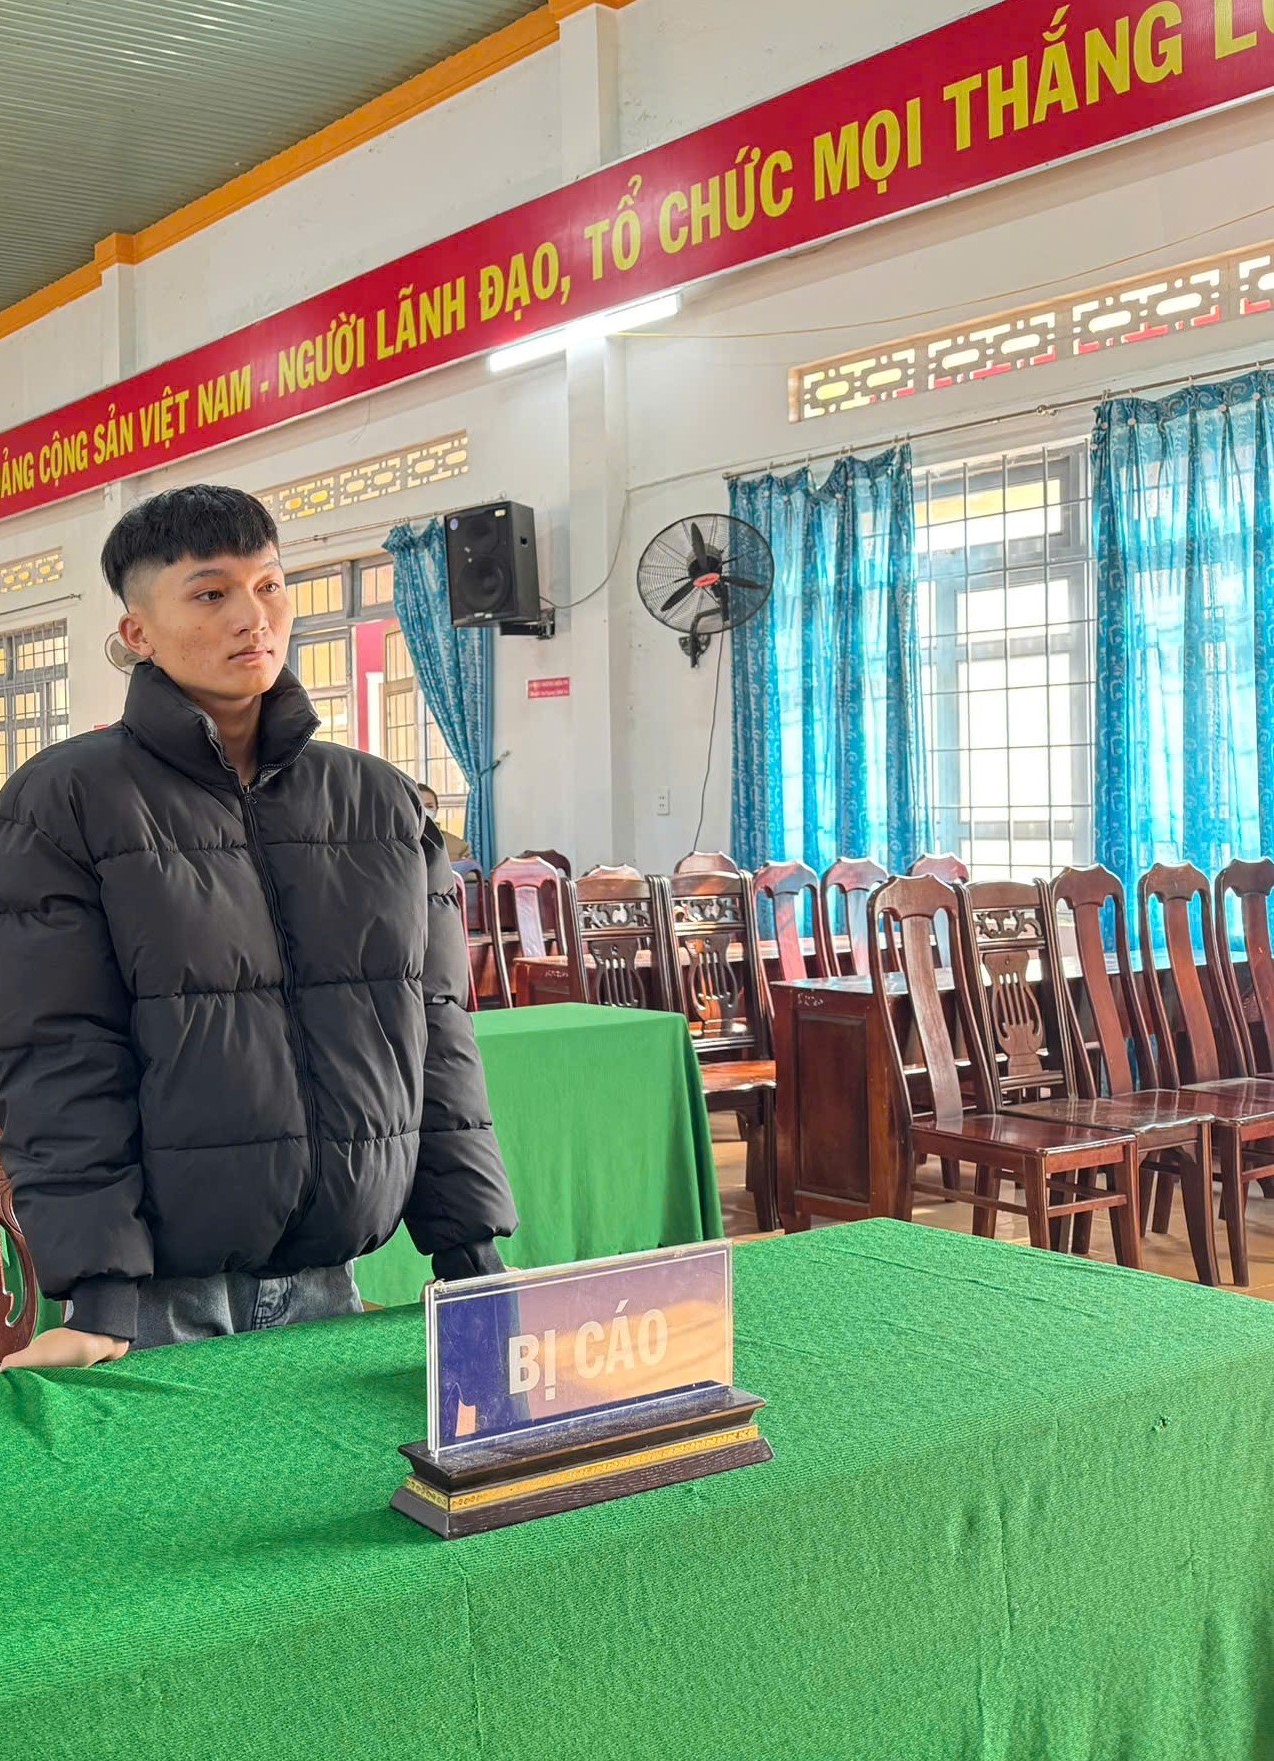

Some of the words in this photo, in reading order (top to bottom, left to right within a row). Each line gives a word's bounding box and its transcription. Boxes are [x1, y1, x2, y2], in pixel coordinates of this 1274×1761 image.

[39, 431, 88, 484] CỘNG
[94, 403, 133, 465] SẢN
[140, 385, 190, 450] VIỆT
[198, 364, 252, 428] NAM
[278, 312, 365, 395] NGƯỜI
[377, 284, 466, 361] LÃNH
[478, 241, 572, 322] ĐẠO,
[584, 174, 643, 281] TỔ
[659, 145, 794, 254] CHỨC
[813, 97, 923, 202] MỌI
[943, 0, 1184, 152] THẮNG
[1215, 0, 1274, 60] L
[507, 1329, 557, 1401] BỊ
[575, 1299, 669, 1380] CÁO
